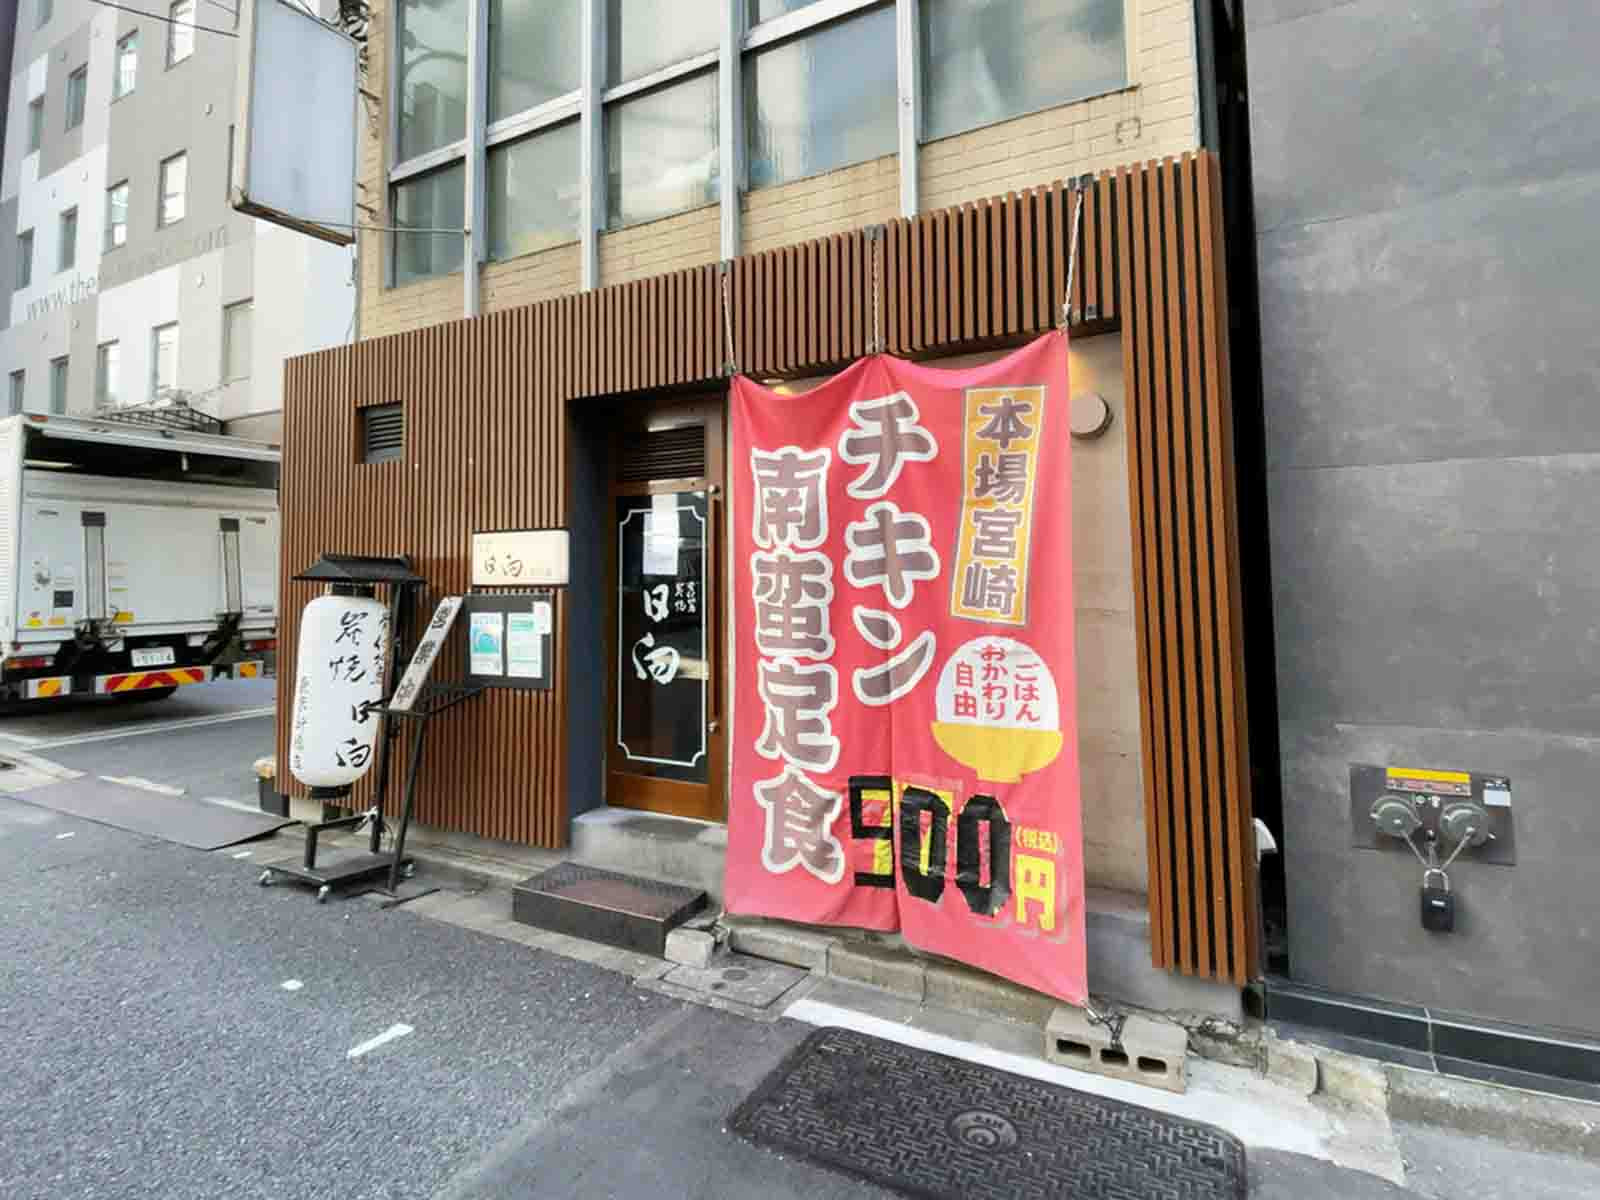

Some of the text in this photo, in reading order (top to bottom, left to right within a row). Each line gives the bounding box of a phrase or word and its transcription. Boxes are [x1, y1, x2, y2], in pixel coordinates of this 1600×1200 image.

[838, 390, 941, 706] チキン
[962, 396, 1034, 616] 本場宮崎
[750, 445, 845, 884] 南蛮定食
[953, 660, 977, 718] 自由
[981, 644, 1008, 721] おかわり
[1014, 663, 1041, 722] ごはん
